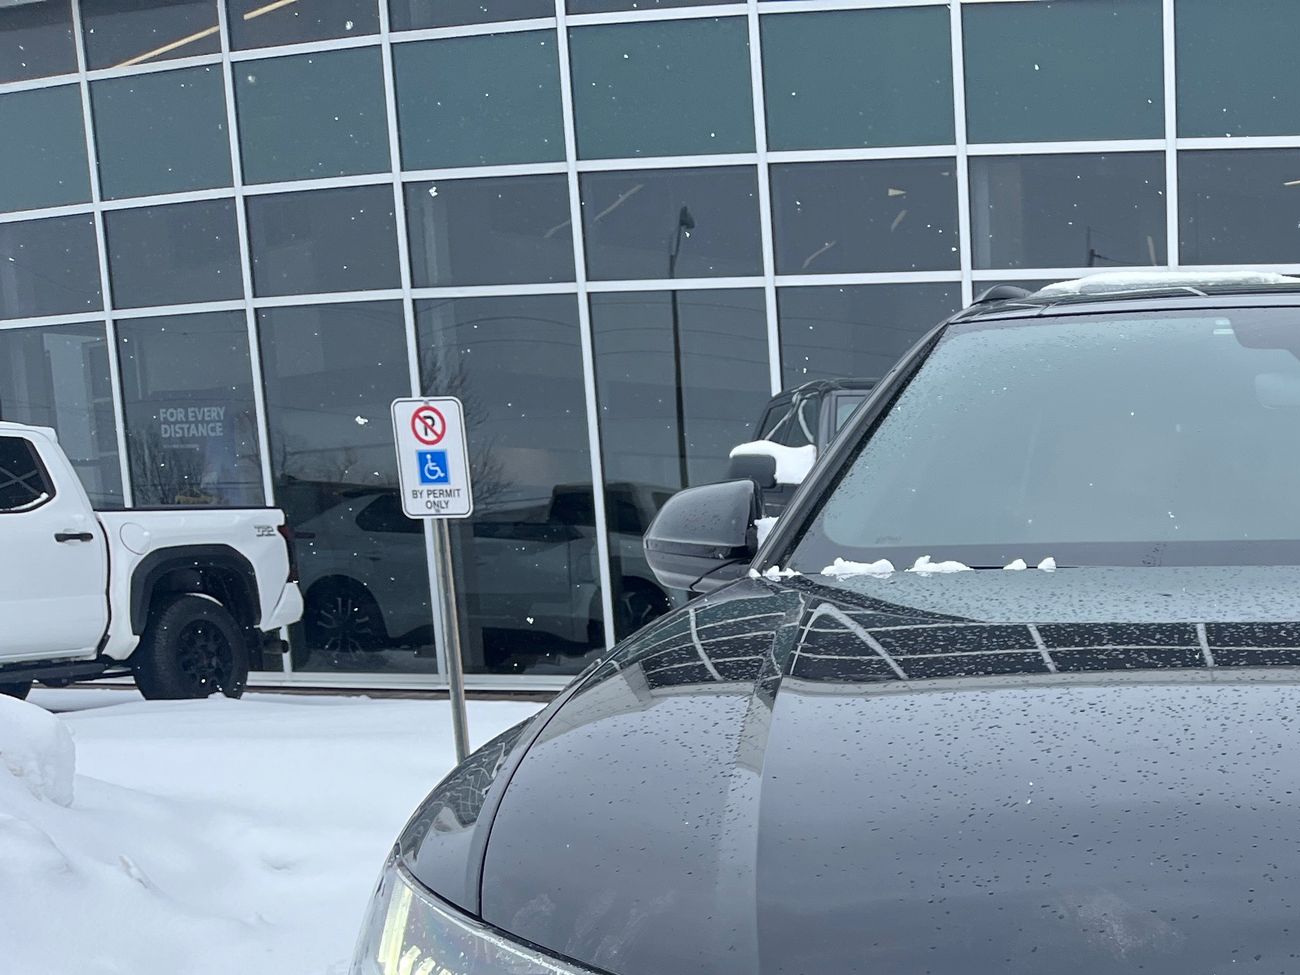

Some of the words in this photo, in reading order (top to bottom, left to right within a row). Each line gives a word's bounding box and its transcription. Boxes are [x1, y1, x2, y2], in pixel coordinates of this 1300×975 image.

[160, 407, 186, 422] FOR
[187, 406, 226, 421] EVERY
[161, 422, 224, 438] DISTANCE
[412, 490, 425, 500] BY
[427, 488, 461, 499] PERMIT
[425, 500, 450, 510] ONLY
